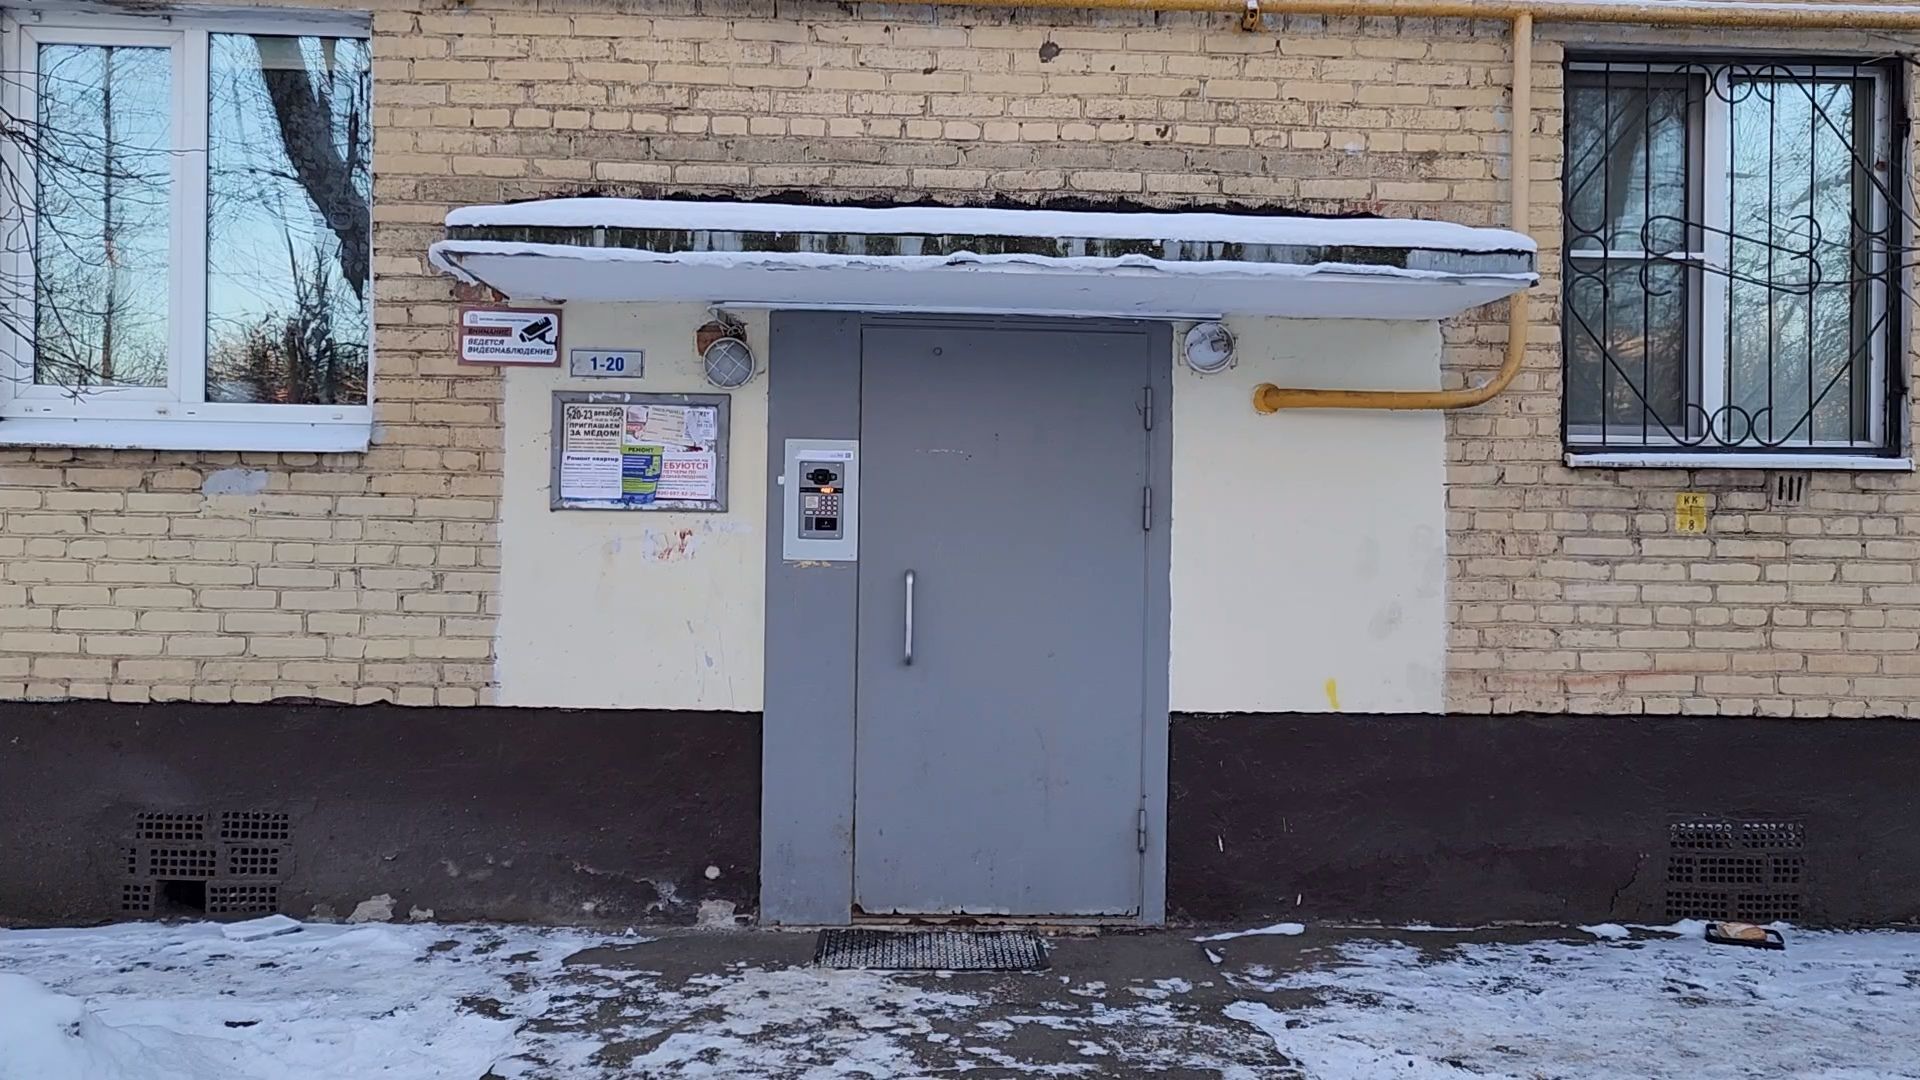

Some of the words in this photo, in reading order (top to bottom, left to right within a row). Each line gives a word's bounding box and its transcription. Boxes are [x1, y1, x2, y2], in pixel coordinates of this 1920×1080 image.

[467, 338, 505, 346] ВЕДЕТСЯ
[467, 346, 554, 356] ВИДЕОНАБЛЮДЕНИЕ!
[590, 356, 625, 371] 1-20
[572, 410, 593, 420] 20-23
[663, 462, 709, 470] ЕБУЮТСЯ
[1688, 520, 1694, 530] 8
